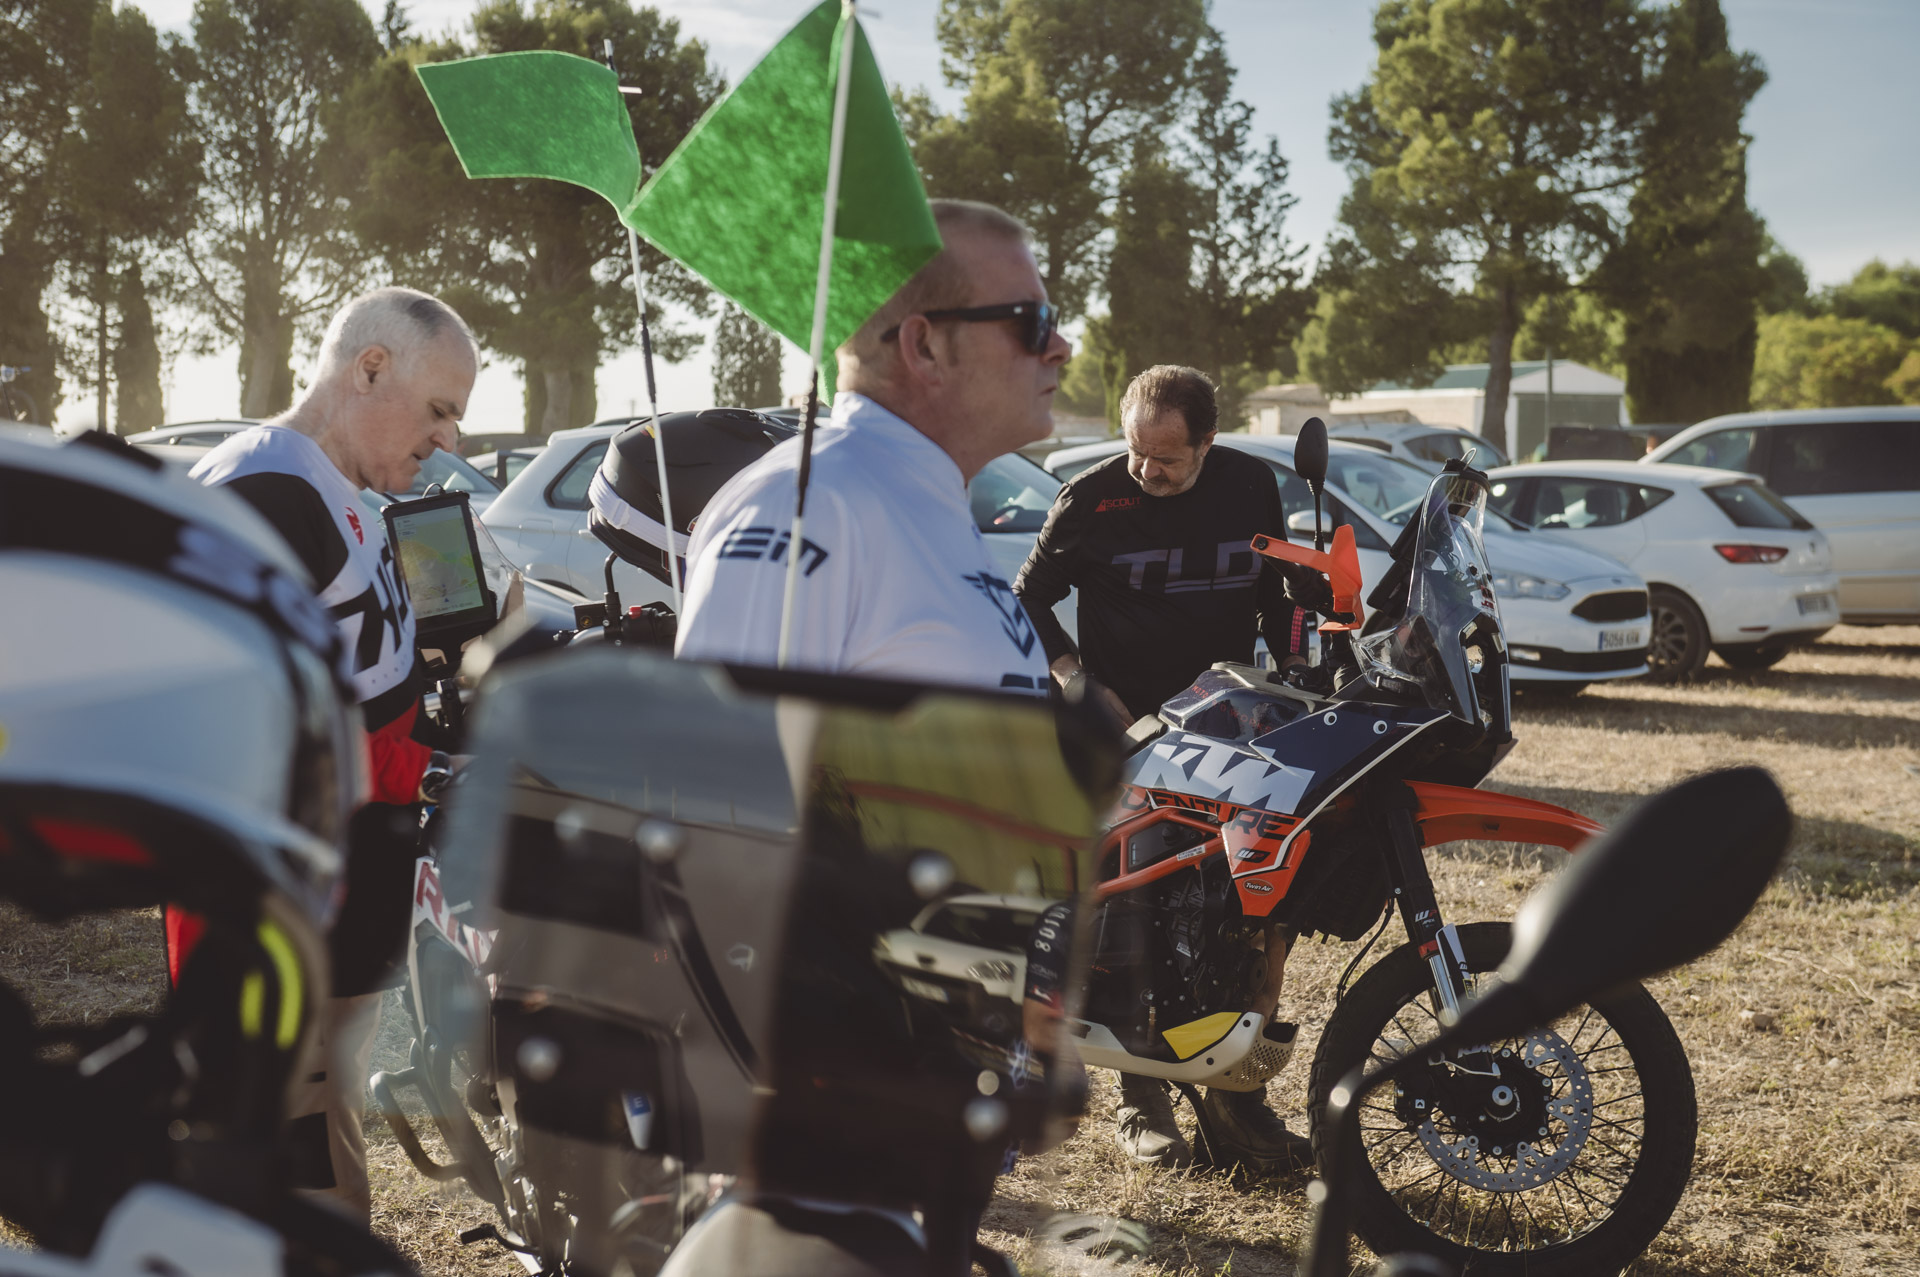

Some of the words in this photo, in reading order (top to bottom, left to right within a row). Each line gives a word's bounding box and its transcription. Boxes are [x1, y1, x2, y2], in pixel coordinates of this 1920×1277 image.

[1111, 539, 1263, 594] TLD
[1131, 734, 1316, 815] KTM
[1246, 882, 1260, 890] Twin
